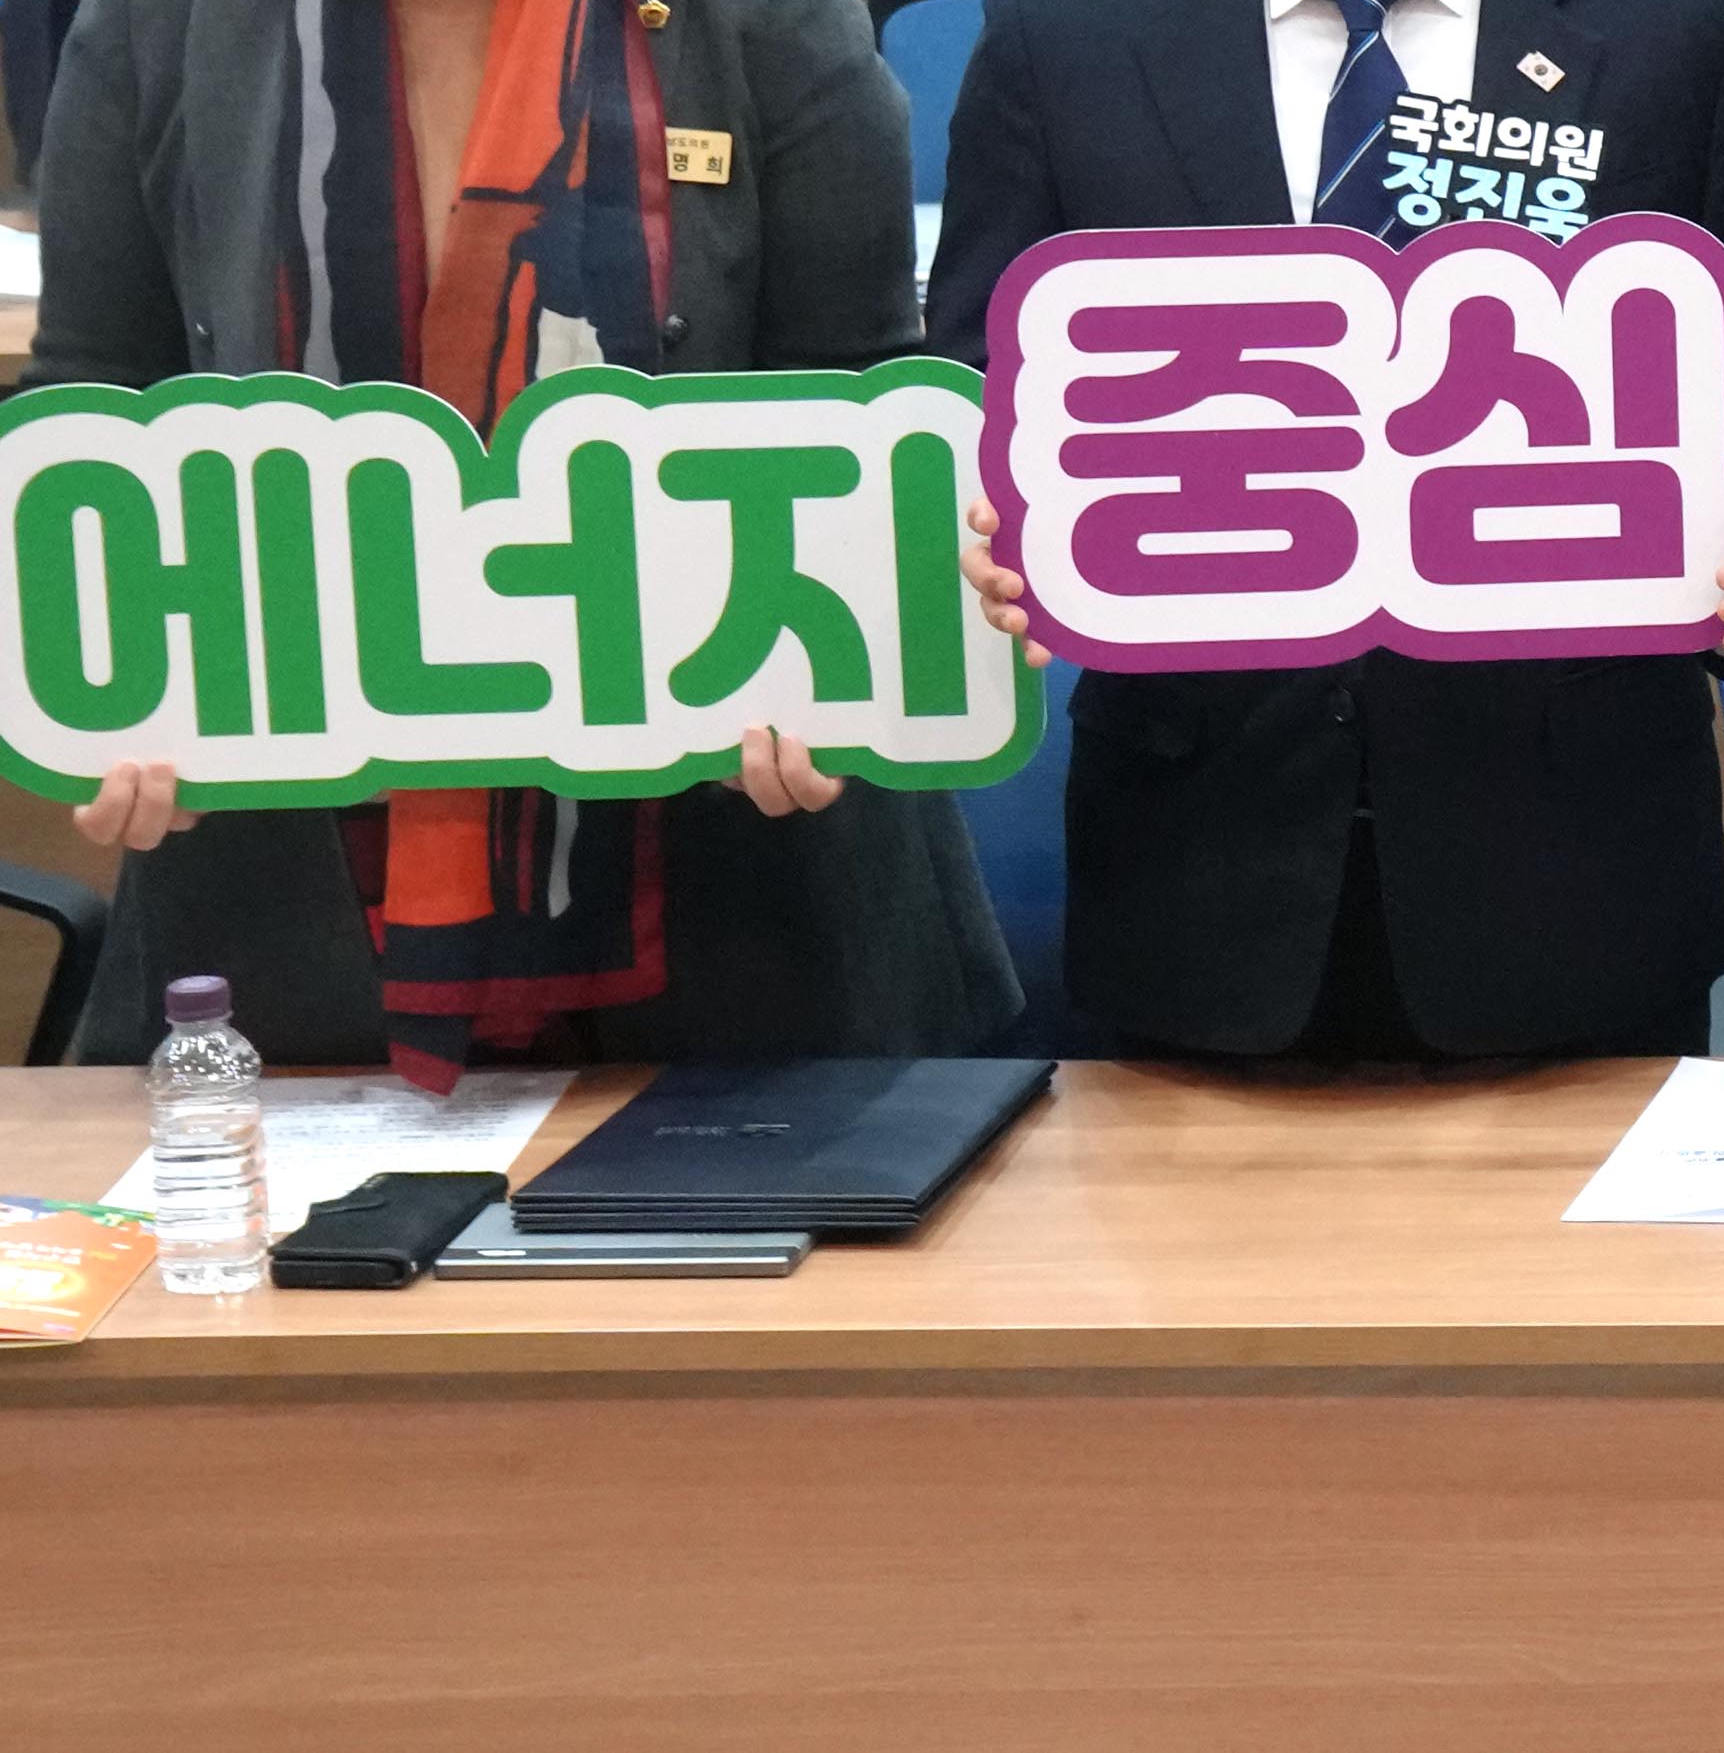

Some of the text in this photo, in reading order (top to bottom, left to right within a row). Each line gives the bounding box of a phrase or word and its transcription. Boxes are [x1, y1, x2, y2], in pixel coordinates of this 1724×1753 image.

[1389, 95, 1604, 181] 국회의원
[14, 428, 970, 741] 에너지
[1062, 286, 1688, 599] 중심
